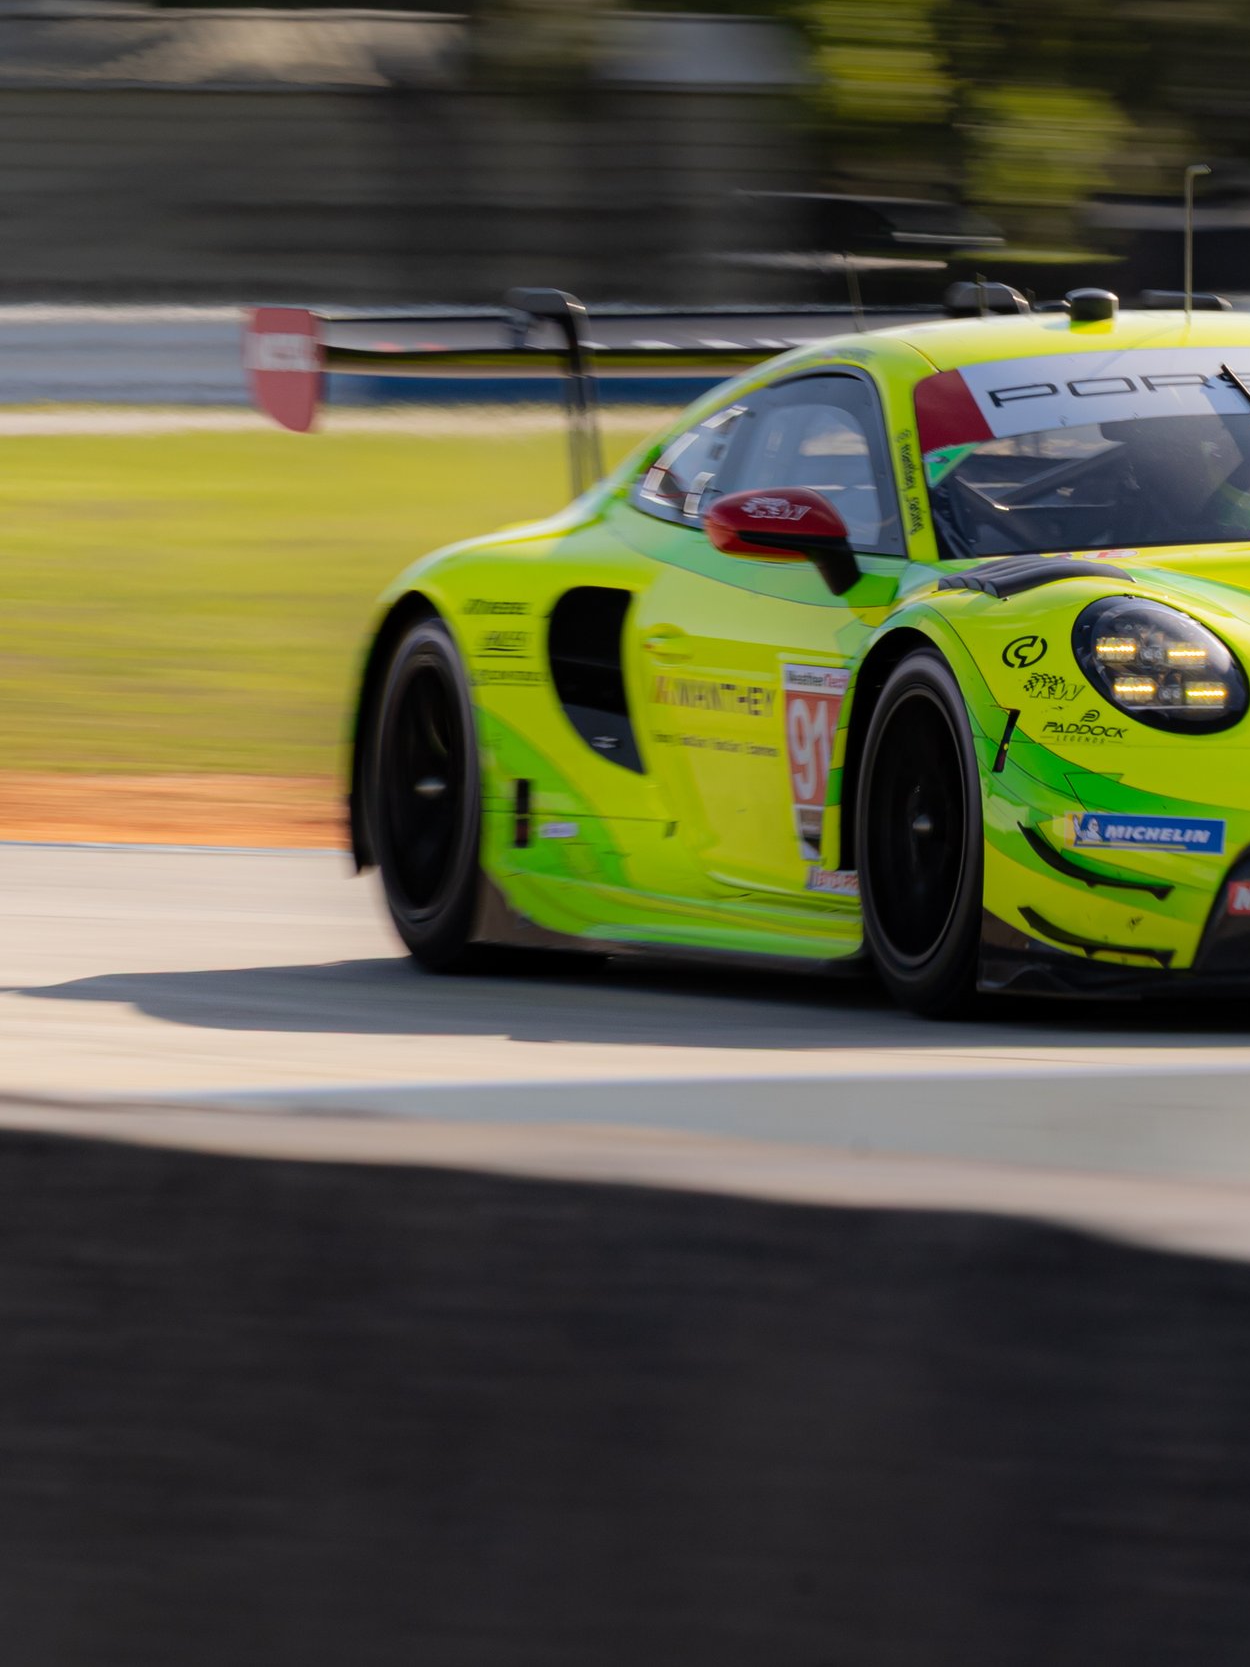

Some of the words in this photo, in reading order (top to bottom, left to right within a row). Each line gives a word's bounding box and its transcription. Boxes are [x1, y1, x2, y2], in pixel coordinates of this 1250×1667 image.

[1042, 721, 1128, 739] PADDOCK
[1056, 734, 1105, 745] LEGENDS
[1104, 823, 1212, 845] MICHELIN
